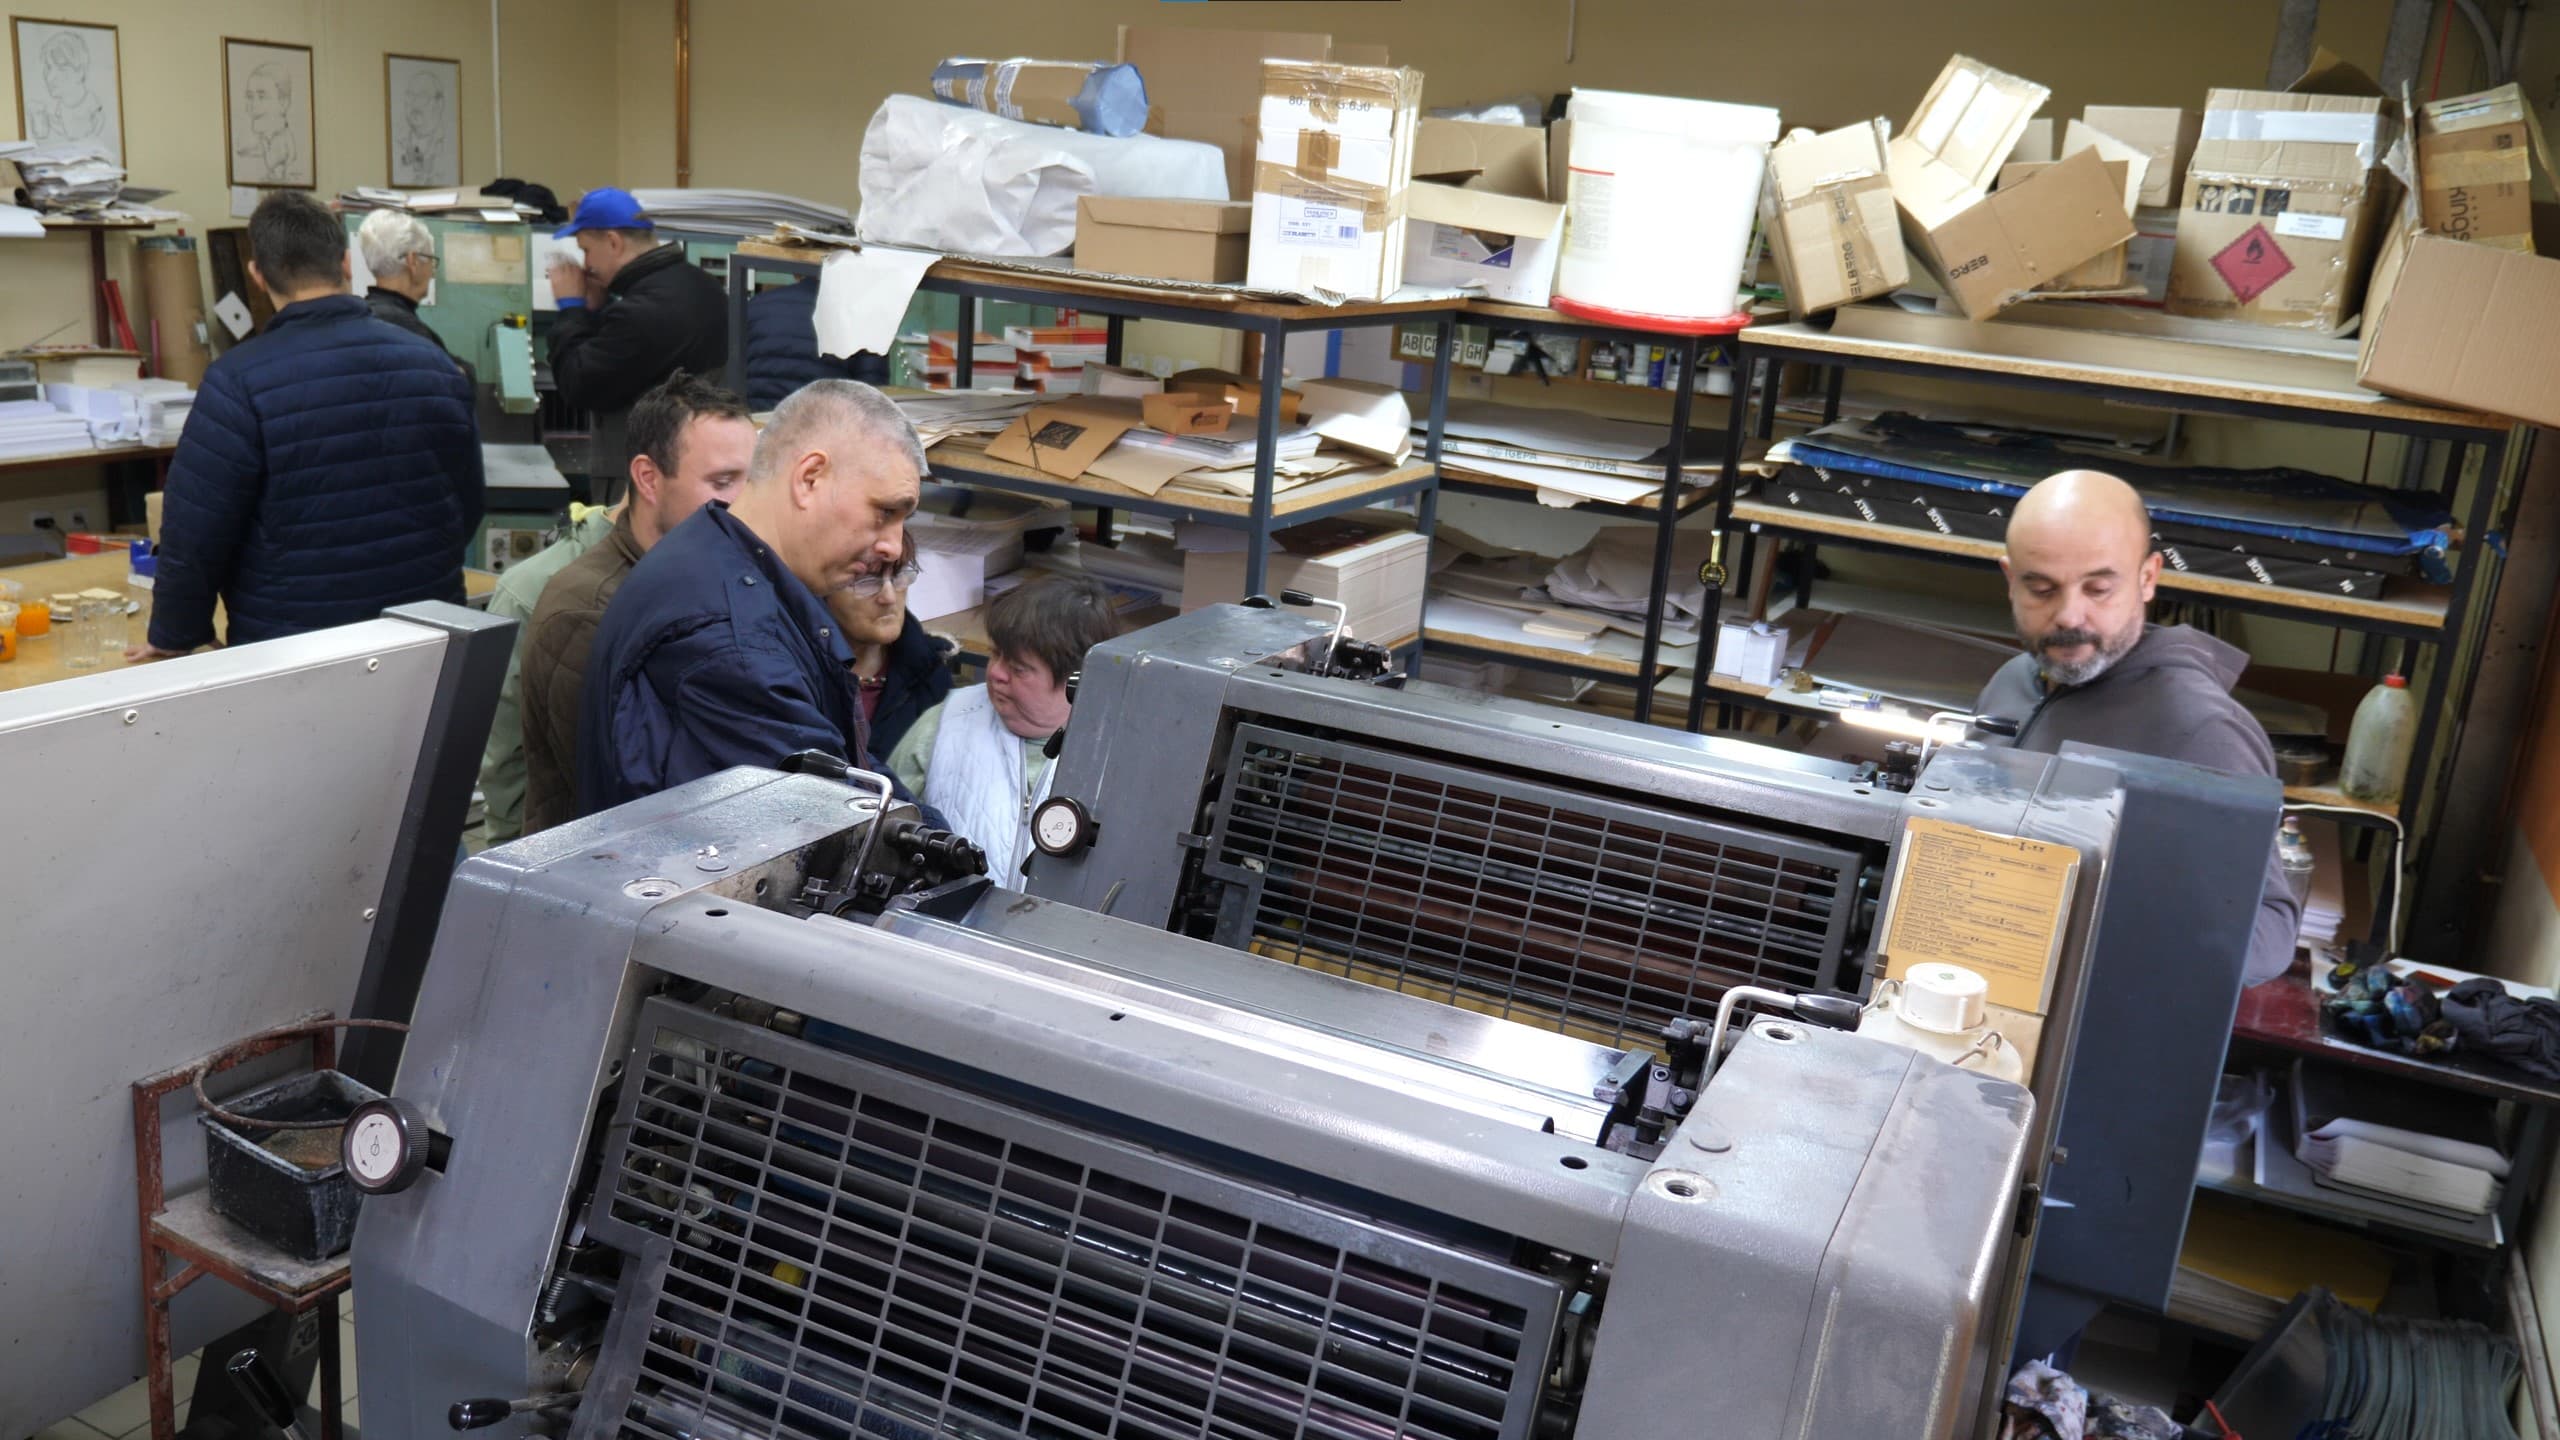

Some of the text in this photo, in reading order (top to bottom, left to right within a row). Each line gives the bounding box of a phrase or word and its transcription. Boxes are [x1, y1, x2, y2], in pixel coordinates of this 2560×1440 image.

[1842, 241, 1862, 298] ELBERG
[1950, 255, 1988, 280] BERG
[1402, 334, 1419, 351] AB
[1465, 344, 1484, 361] GH
[1504, 448, 1537, 462] IGEPA
[1854, 498, 1876, 522] ITALY
[1926, 507, 1952, 535] MADE
[2163, 546, 2188, 572] ITALY
[2246, 556, 2274, 585] MADE
